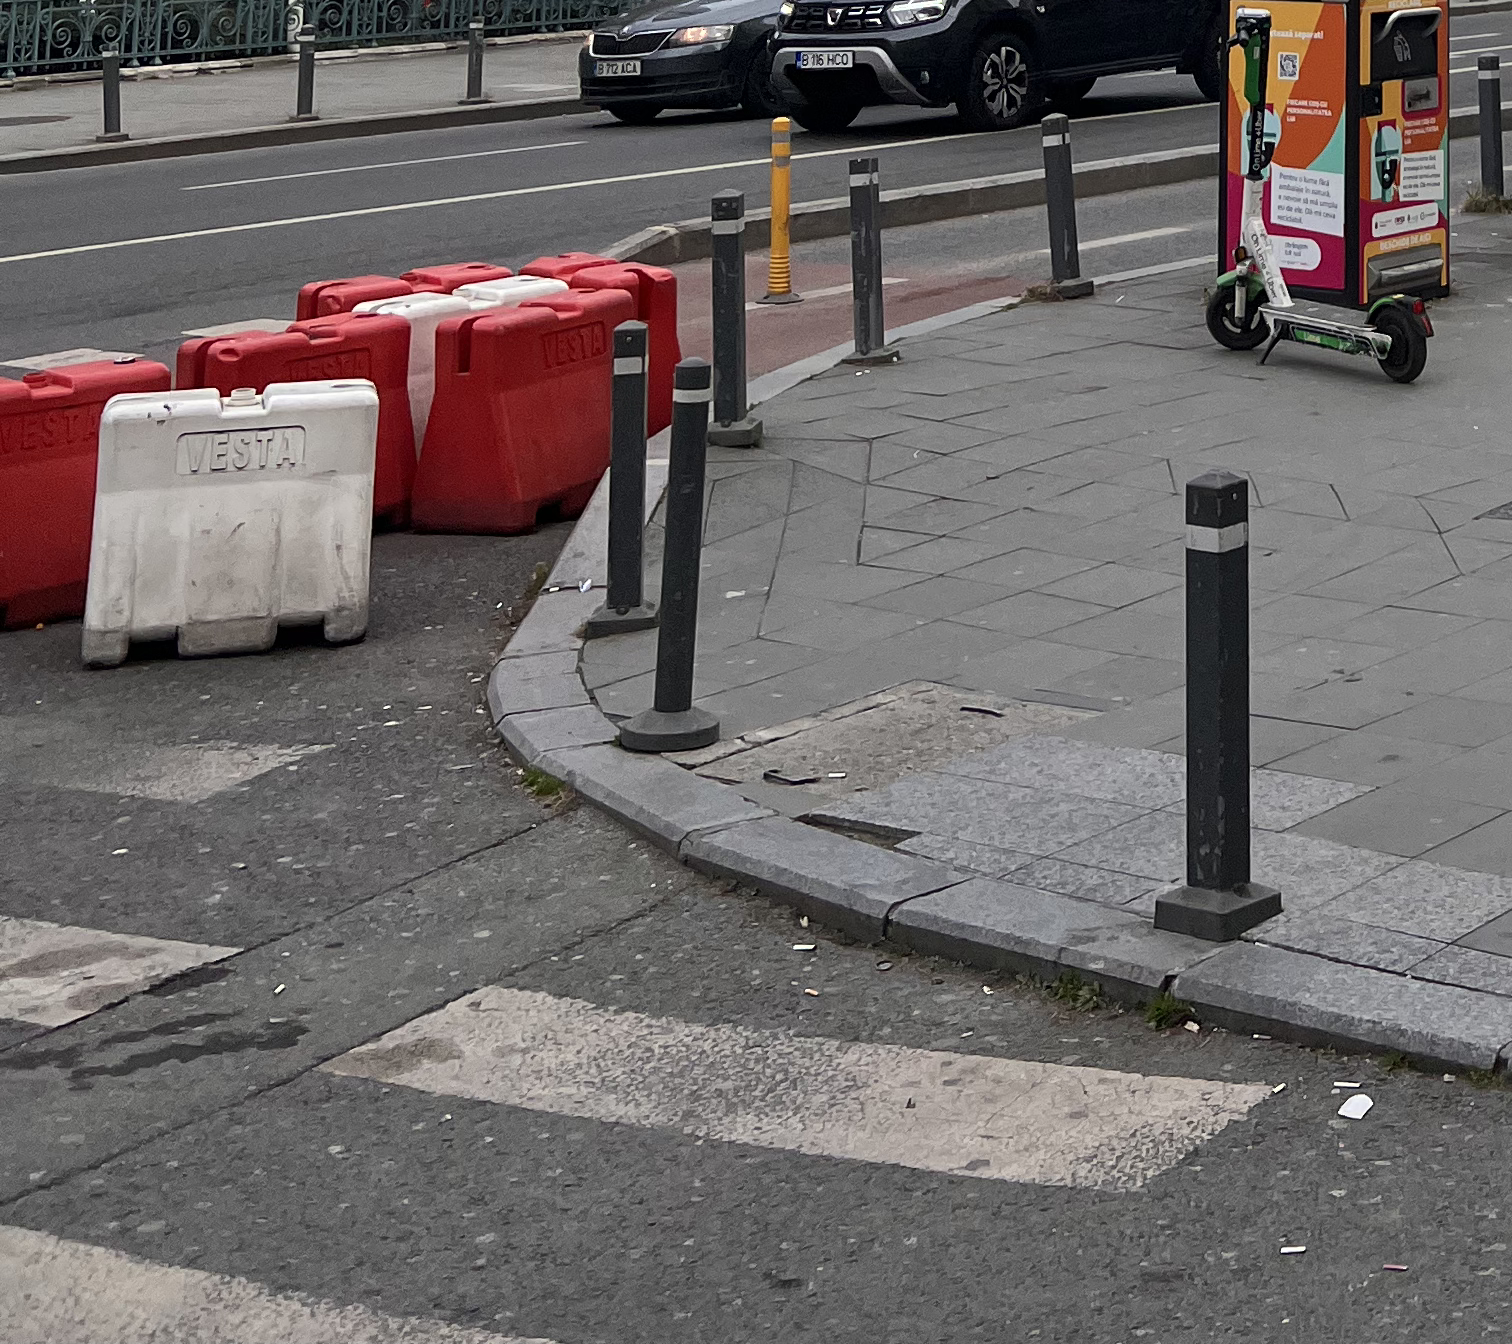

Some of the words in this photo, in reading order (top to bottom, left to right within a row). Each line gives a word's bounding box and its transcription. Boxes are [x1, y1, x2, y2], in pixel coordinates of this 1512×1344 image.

[597, 62, 605, 76] B
[801, 52, 809, 68] B
[811, 52, 824, 67] 116
[825, 52, 849, 67] HCO
[543, 324, 604, 369] VESTA
[186, 430, 297, 474] VESTA
